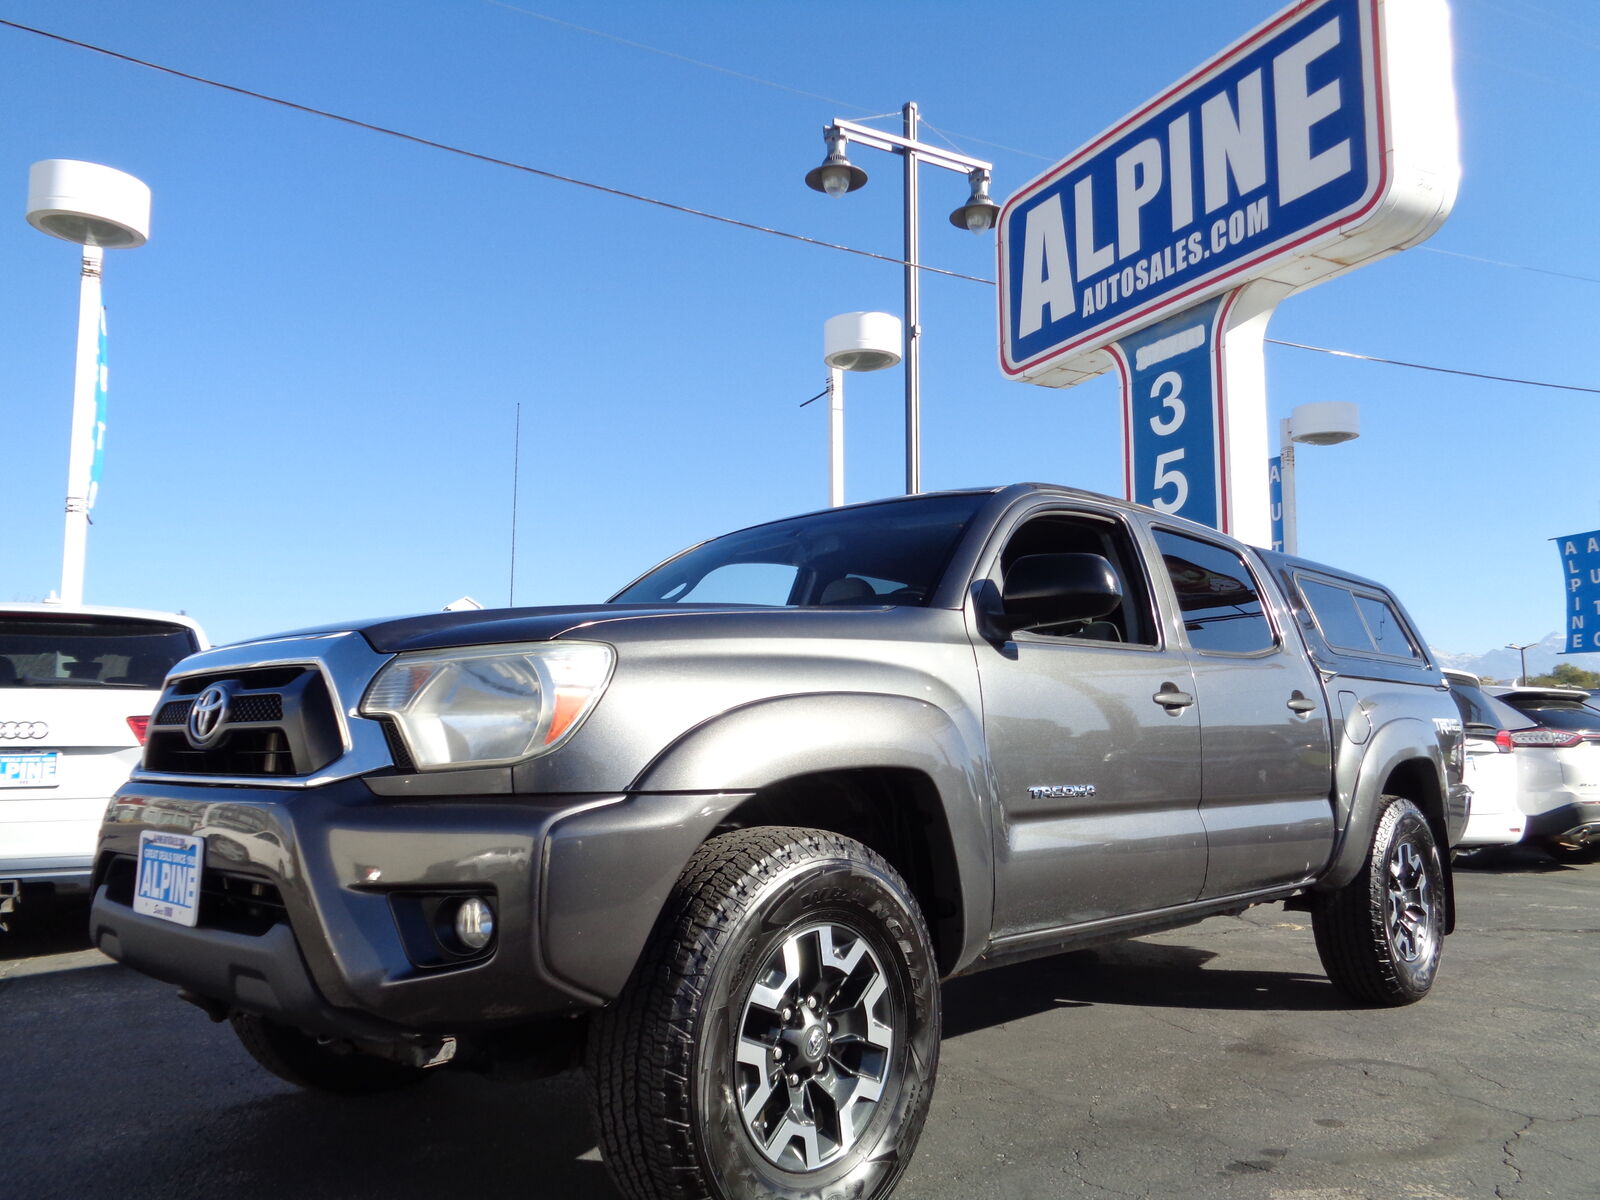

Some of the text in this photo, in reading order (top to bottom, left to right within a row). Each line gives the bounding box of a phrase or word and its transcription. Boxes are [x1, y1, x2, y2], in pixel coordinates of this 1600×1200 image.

[1019, 16, 1352, 339] ALPINE
[1081, 197, 1270, 318] AUTOSALES.COM
[1565, 541, 1584, 648] ALPINE
[140, 860, 196, 907] ALPINE
